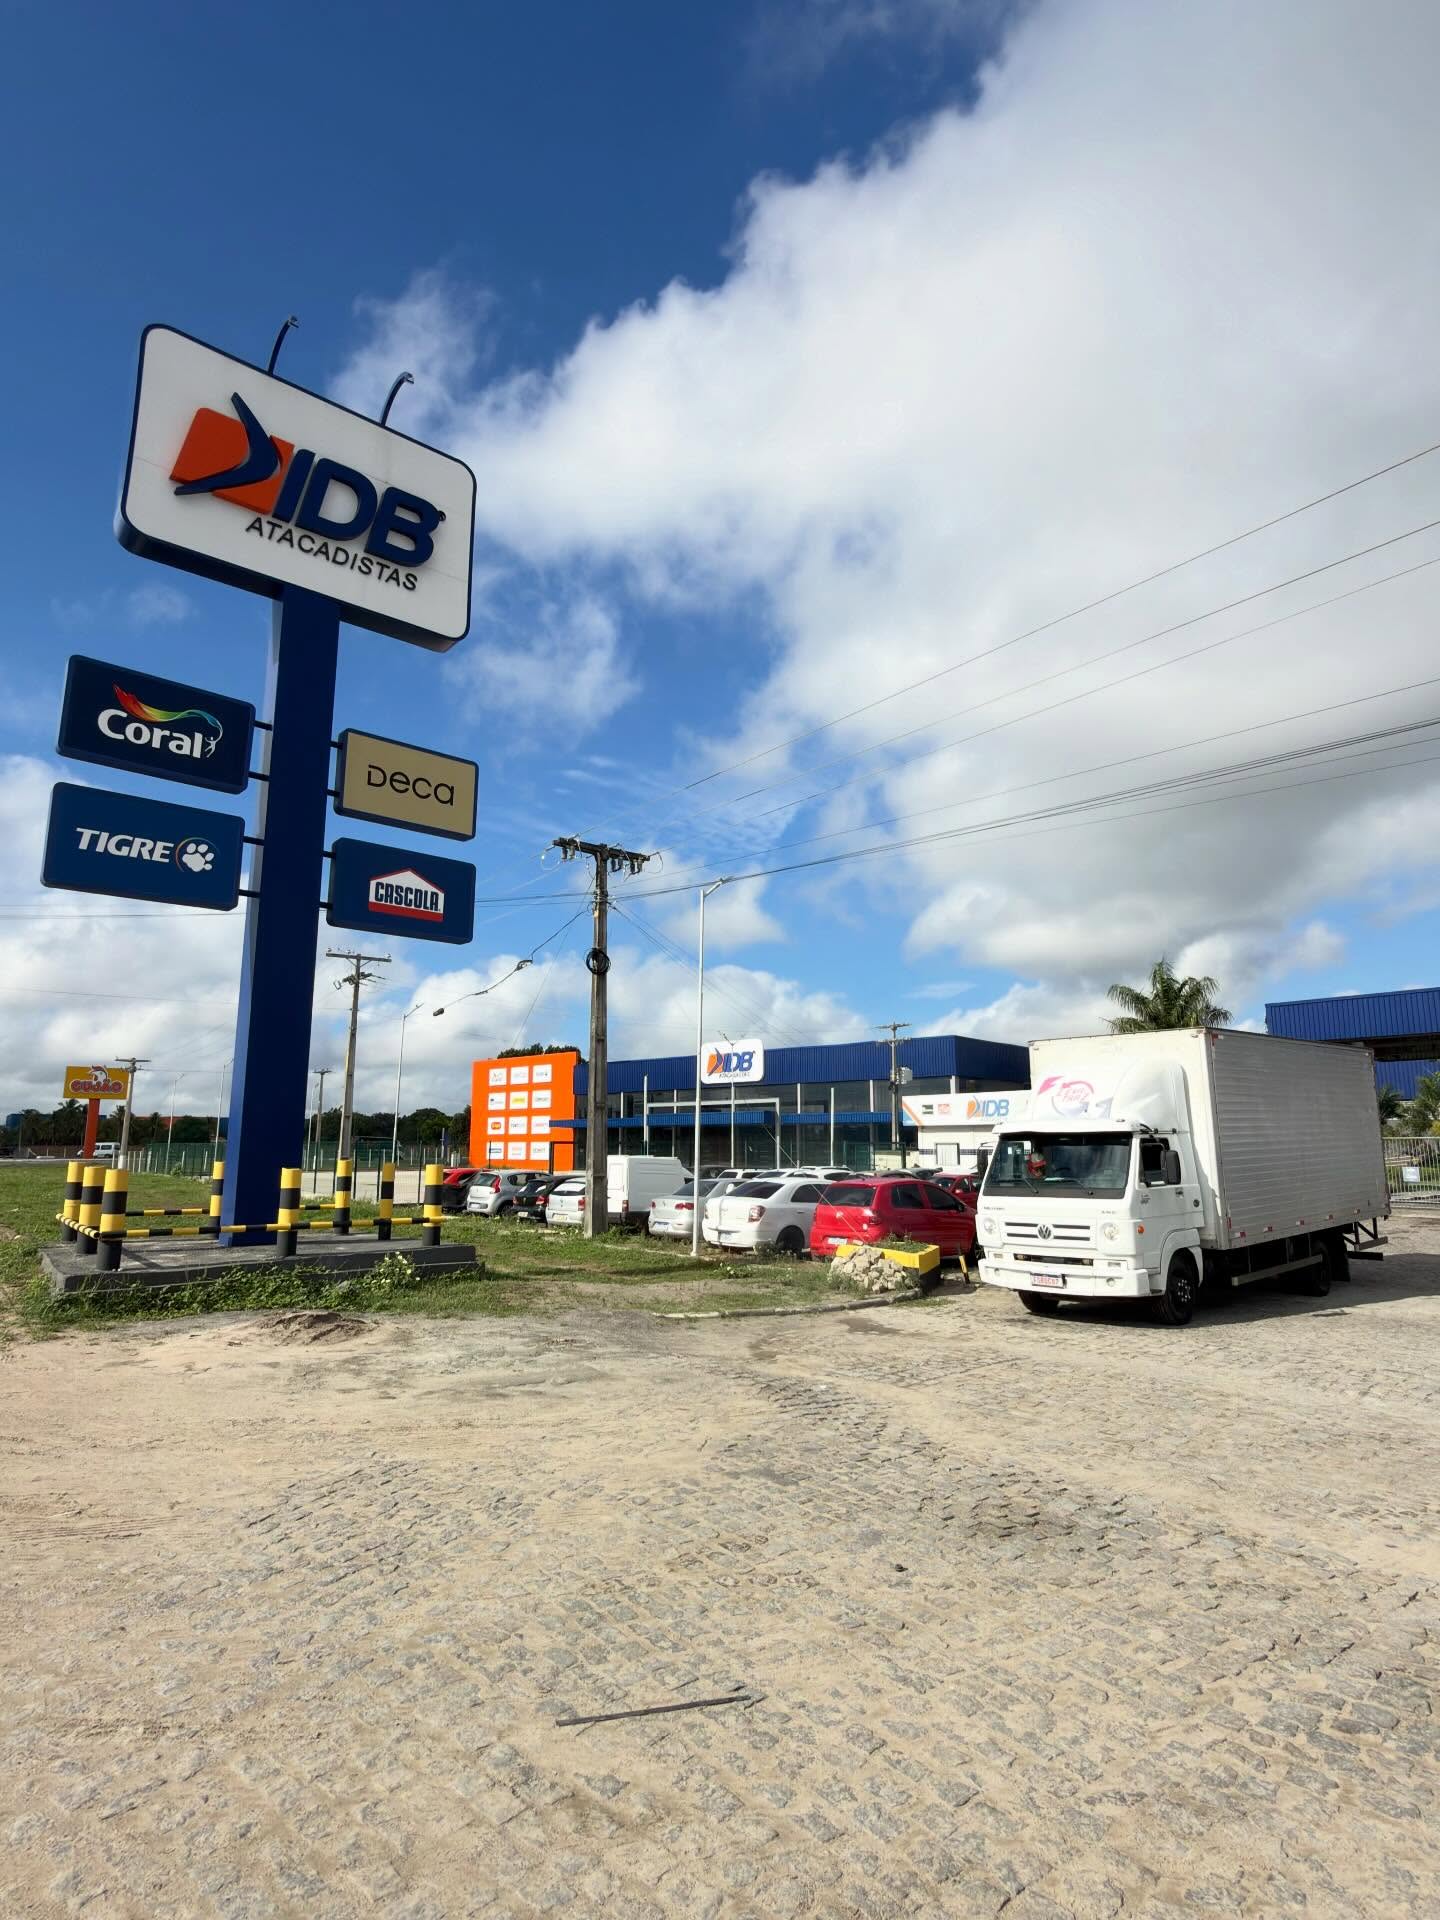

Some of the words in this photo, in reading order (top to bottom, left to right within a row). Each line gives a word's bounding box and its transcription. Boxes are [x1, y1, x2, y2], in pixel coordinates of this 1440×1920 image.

[245, 516, 418, 592] ATACADISTAS
[97, 708, 203, 759] Coral
[367, 764, 455, 806] Deca
[75, 827, 174, 863] TIGRE
[374, 881, 440, 912] CASCOLA
[983, 1099, 1010, 1117] IDB
